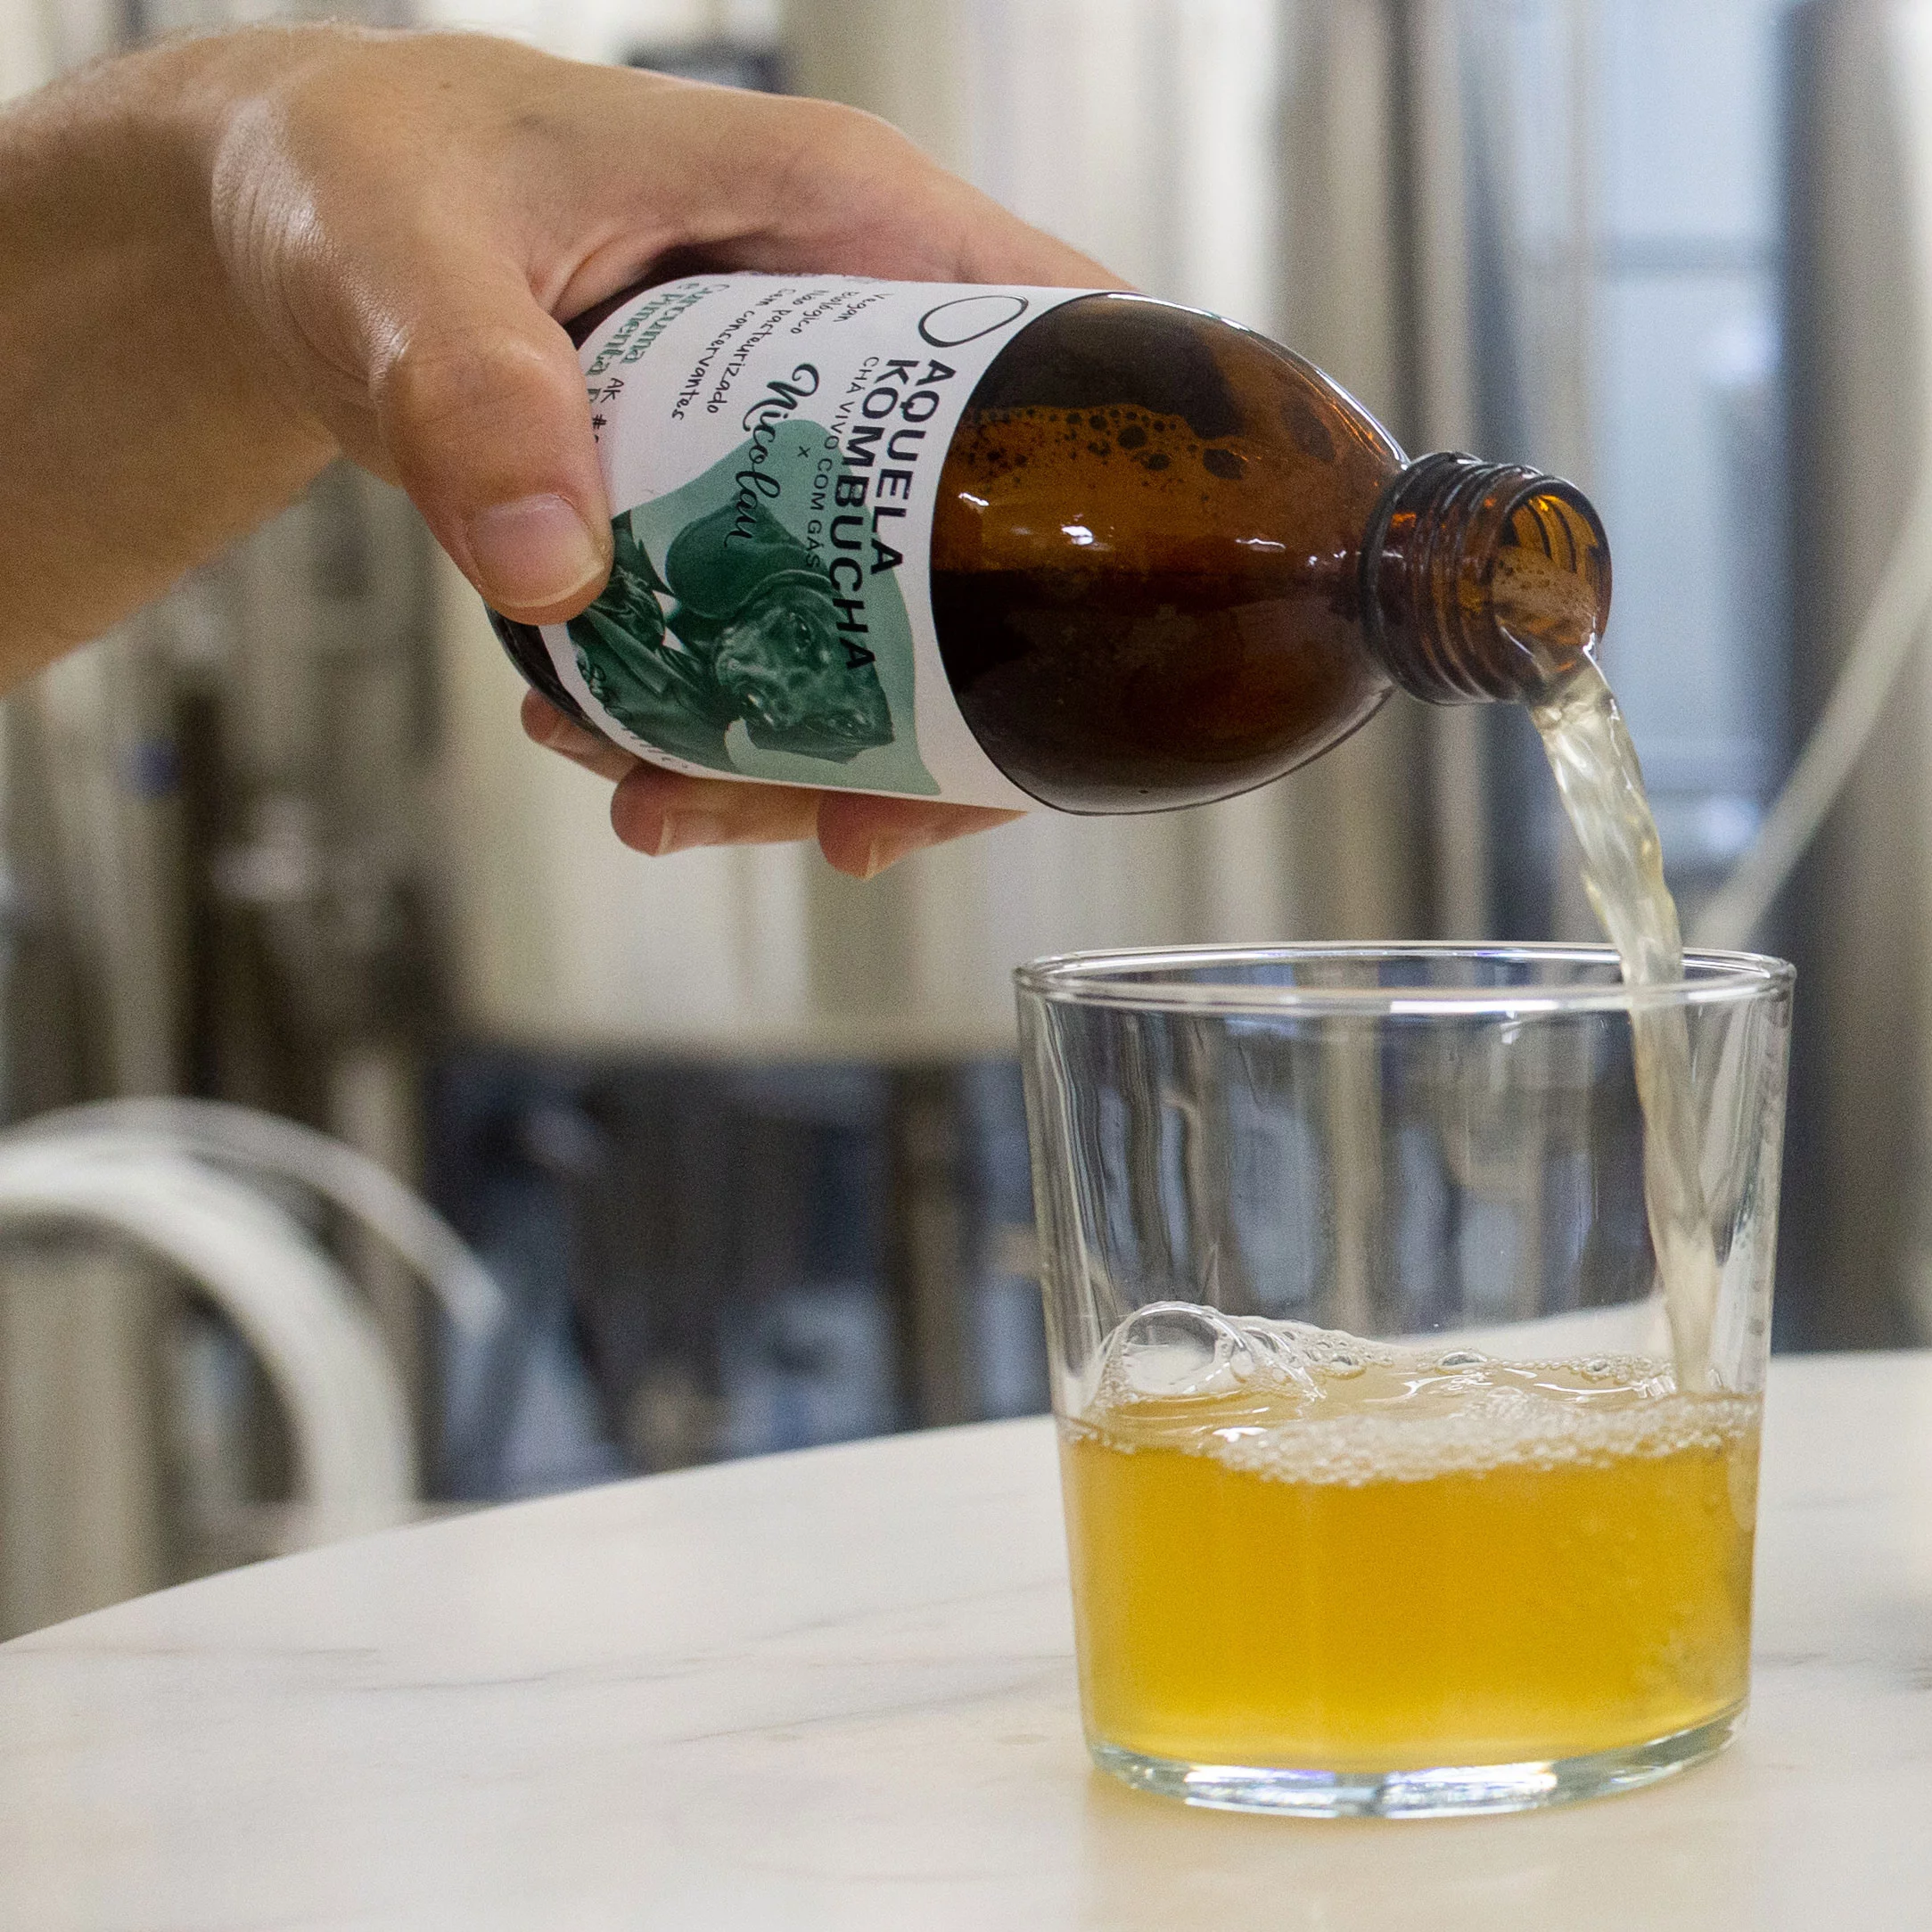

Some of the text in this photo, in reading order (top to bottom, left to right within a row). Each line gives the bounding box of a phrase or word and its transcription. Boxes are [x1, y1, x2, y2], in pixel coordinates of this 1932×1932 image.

[601, 378, 625, 403] AK
[672, 310, 755, 420] conservantes
[833, 292, 894, 322] Vegan
[724, 363, 819, 548] Nicolau
[805, 357, 879, 569] CHÁ VIVO COM GÁS
[829, 359, 920, 669] KOMBUCHA
[870, 358, 958, 575] AQUELA
